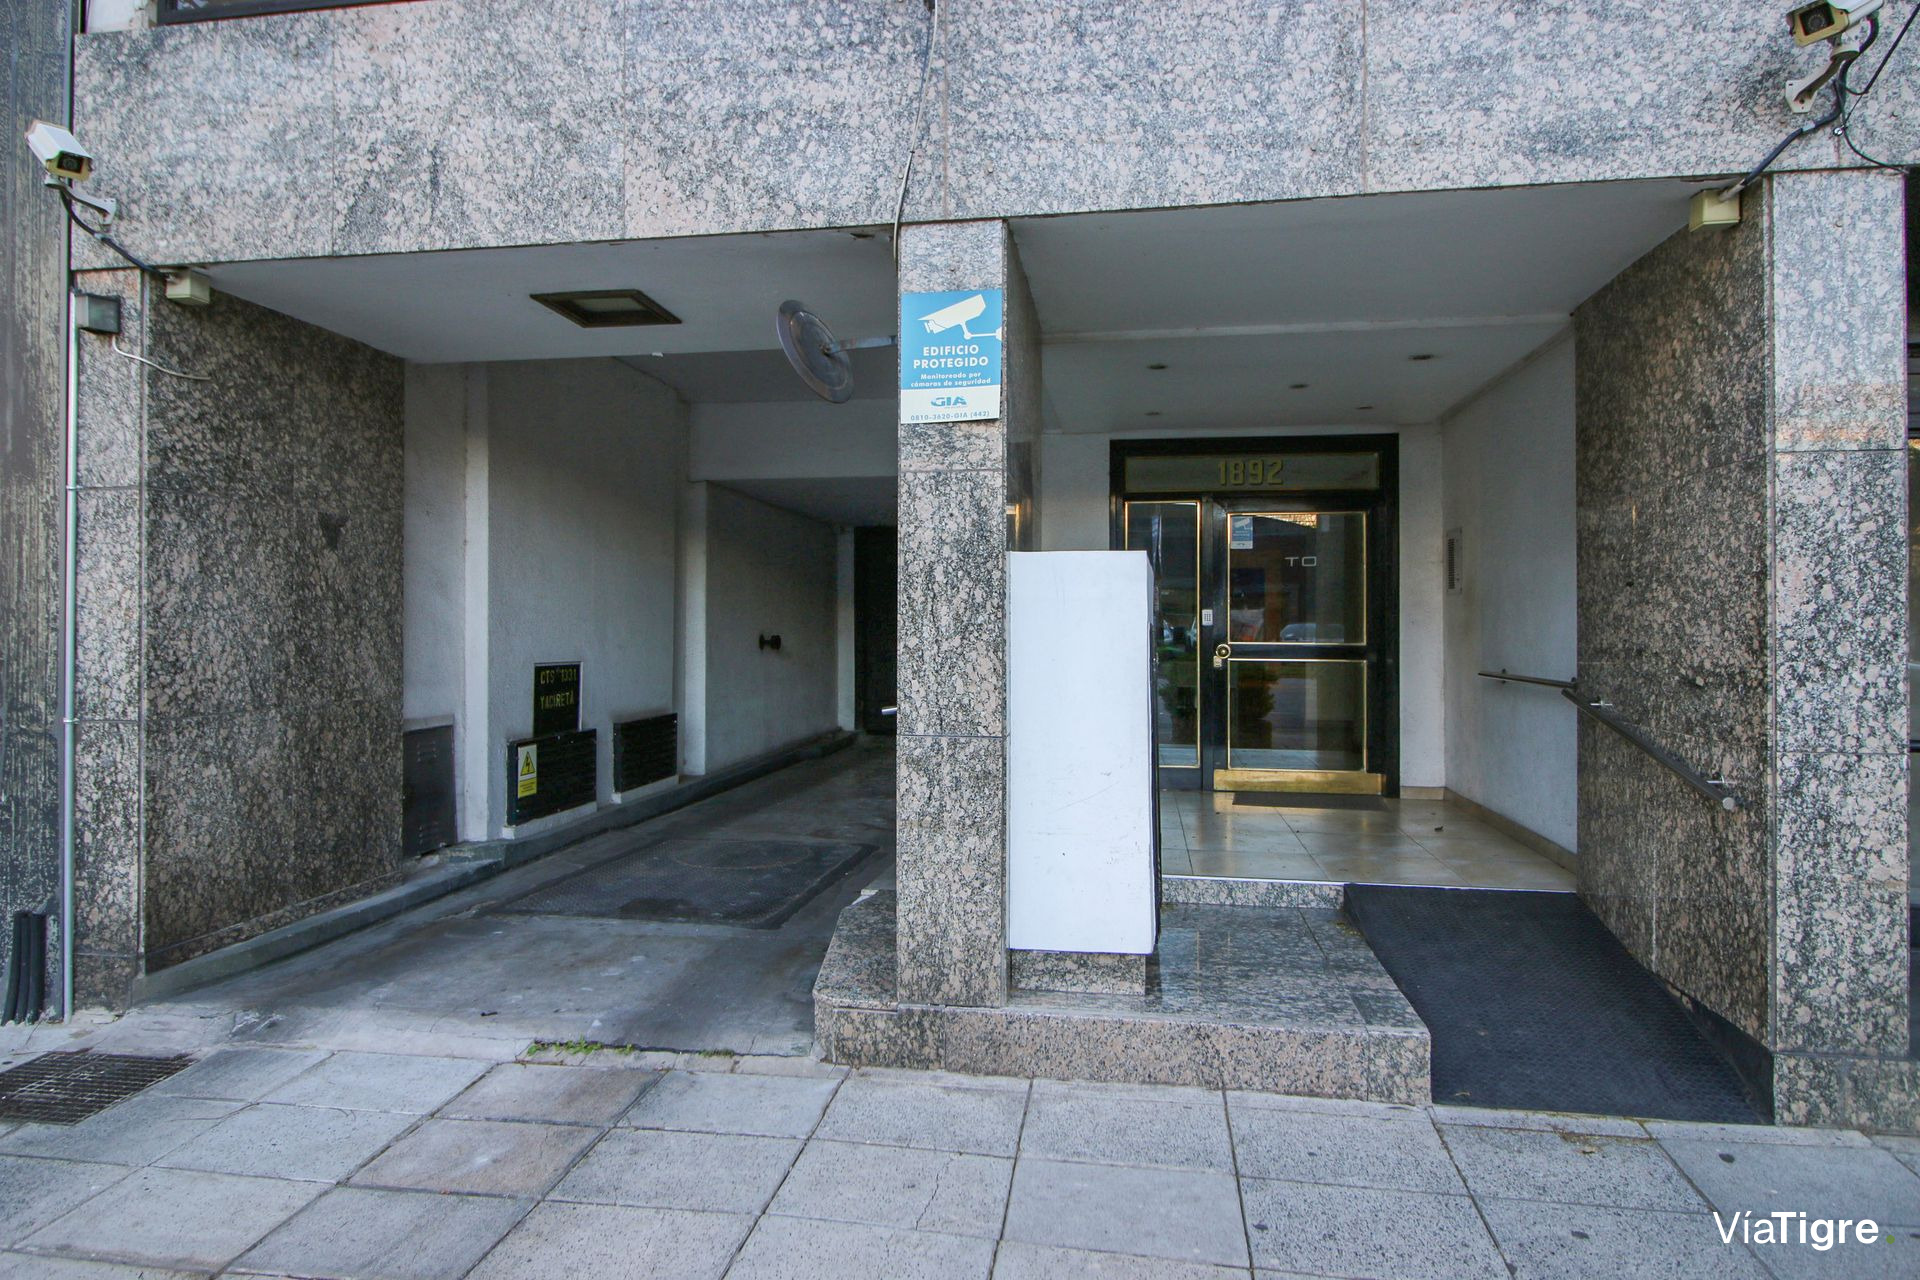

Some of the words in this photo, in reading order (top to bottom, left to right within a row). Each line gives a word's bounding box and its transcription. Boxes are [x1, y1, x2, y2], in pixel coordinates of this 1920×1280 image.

[923, 344, 979, 356] EDIFICIO
[913, 356, 989, 369] PROTEGIDO
[920, 372, 967, 380] Monitoreado
[969, 371, 982, 379] por
[943, 379, 953, 387] de
[954, 377, 991, 387] seguridad
[930, 396, 967, 407] GIA
[1216, 458, 1285, 487] 1892
